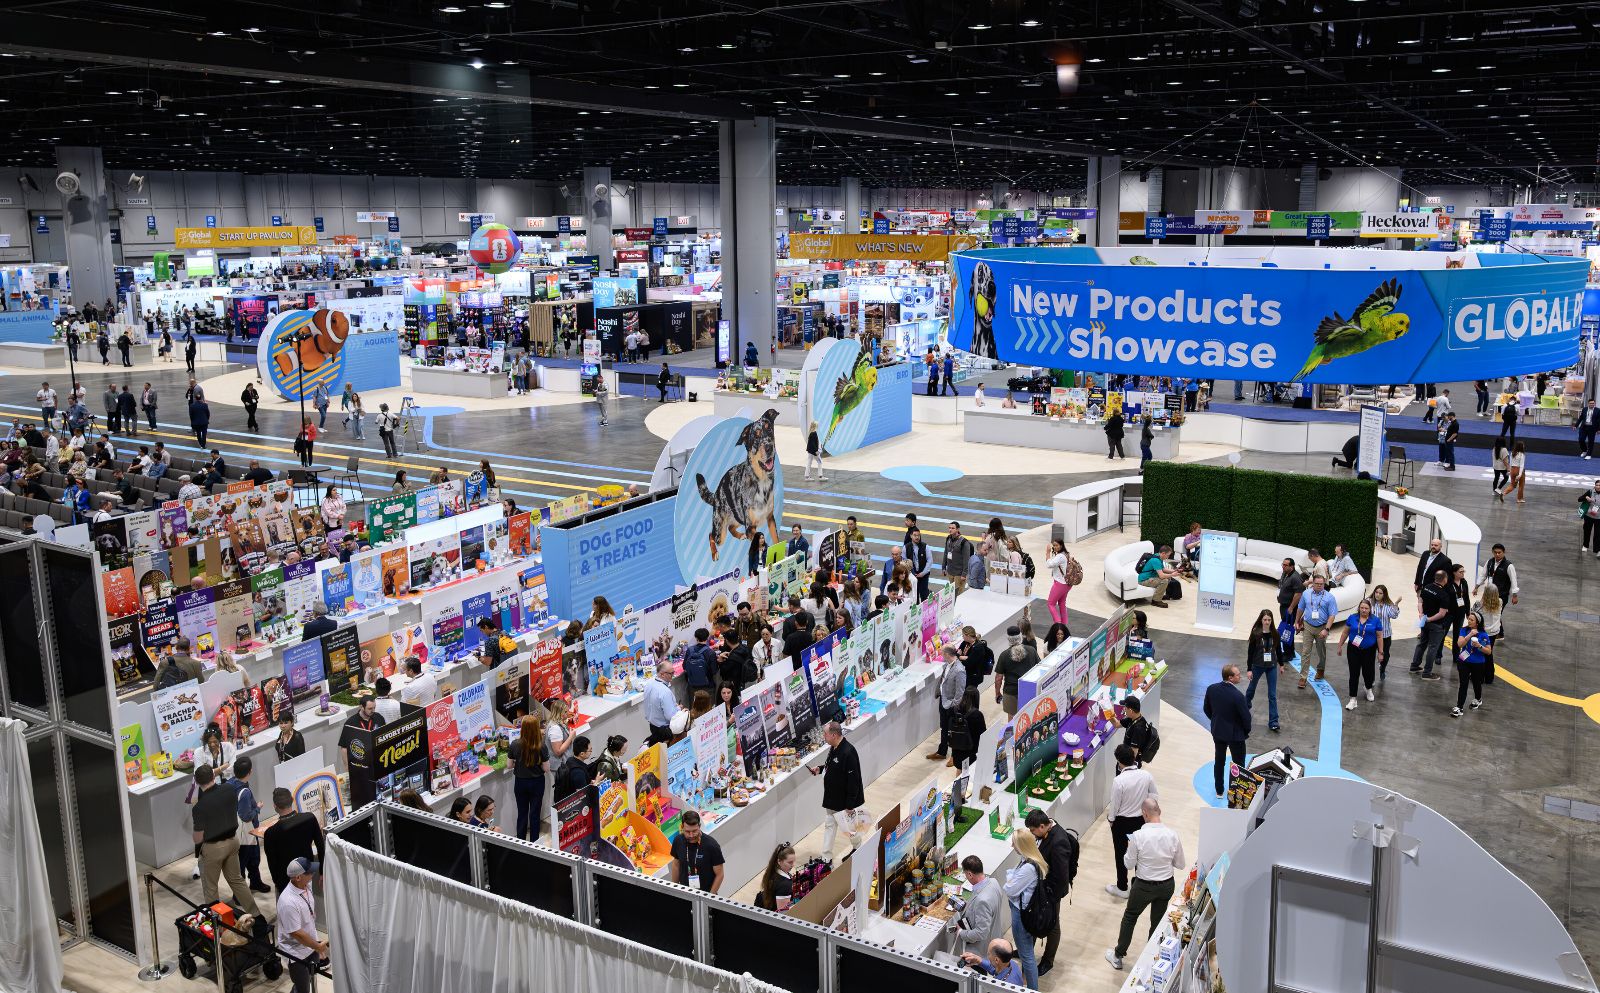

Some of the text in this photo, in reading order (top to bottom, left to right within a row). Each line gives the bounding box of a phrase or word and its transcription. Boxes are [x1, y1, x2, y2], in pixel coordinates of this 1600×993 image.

[528, 219, 544, 227] EXIT
[571, 219, 581, 227] XIT
[1368, 215, 1430, 228] Heckova!
[189, 230, 212, 239] Global
[219, 231, 293, 241] START UP PAVILION
[804, 238, 831, 247] Global
[856, 242, 925, 253] WHAT'S NEW
[593, 280, 617, 288] Nashi
[593, 287, 610, 297] Day
[1013, 283, 1282, 327] New Products
[22, 314, 50, 322] ANIMAL
[671, 312, 686, 320] Nashi
[1455, 298, 1572, 343] GLOBAL
[597, 318, 618, 326] Nashi
[597, 325, 612, 333] Day
[364, 337, 395, 346] AQUATIC
[1068, 326, 1277, 369] Showcase
[896, 369, 908, 380] BIRD
[580, 517, 654, 556] DOG FOOD
[580, 539, 647, 576] & TREATS
[1209, 598, 1231, 607] Global
[144, 615, 175, 628] SEARCH FOR
[151, 613, 167, 621] YOUR
[674, 613, 697, 629] BAKERY
[150, 623, 171, 633] TREATS
[147, 633, 161, 642] ENDS
[162, 705, 197, 722] TRACHEA
[170, 713, 193, 726] BALLS
[378, 729, 400, 743] SAVORY
[379, 729, 420, 768] New!
[559, 818, 588, 840] SMOKED
